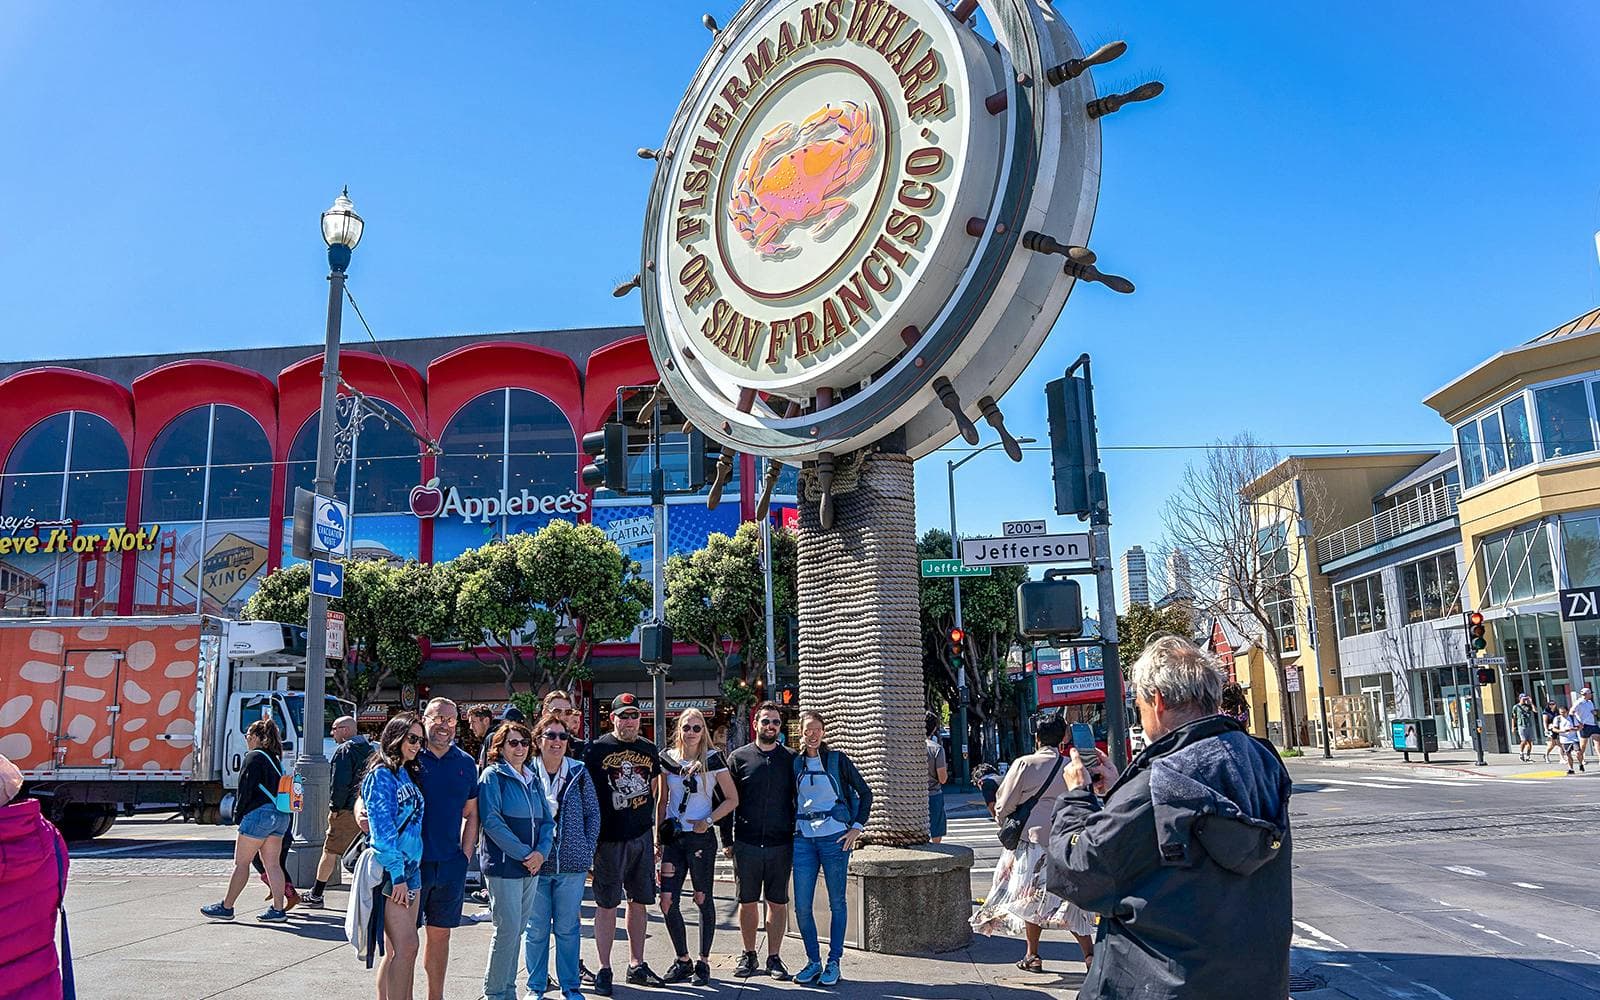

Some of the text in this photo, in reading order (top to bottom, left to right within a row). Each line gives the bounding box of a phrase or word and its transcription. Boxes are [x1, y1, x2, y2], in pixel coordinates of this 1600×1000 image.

[676, 0, 949, 245] FISHERMANS WHARF
[679, 146, 945, 366] OF SAN FRANCISCO
[439, 486, 589, 524] Applebee's
[44, 529, 68, 553] It
[72, 534, 100, 553] or
[103, 524, 160, 552] Not!
[1007, 523, 1032, 534] 200
[975, 543, 1079, 561] Jefferson
[208, 567, 248, 589] XING
